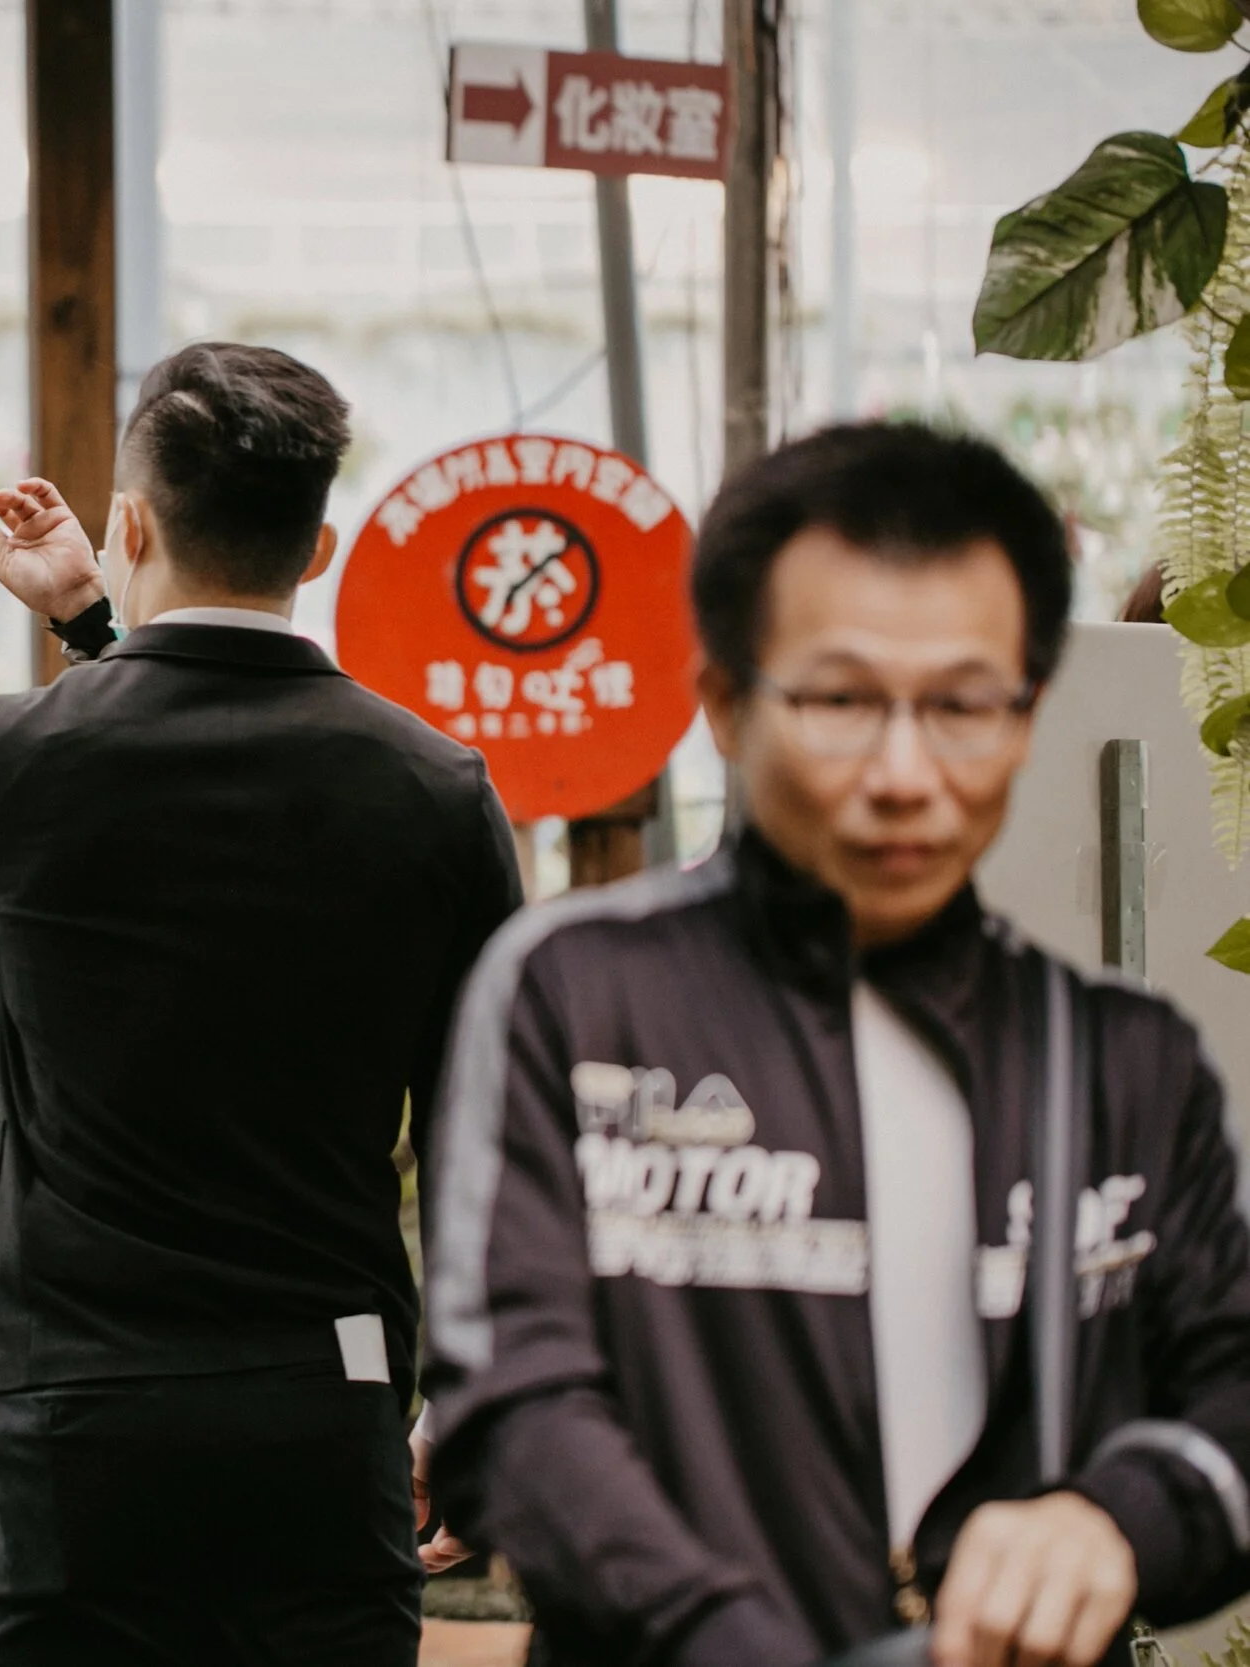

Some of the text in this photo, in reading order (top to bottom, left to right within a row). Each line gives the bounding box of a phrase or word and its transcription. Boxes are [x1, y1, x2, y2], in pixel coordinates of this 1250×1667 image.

[553, 72, 724, 162] 化妝室
[574, 1133, 821, 1223] MOTOR
